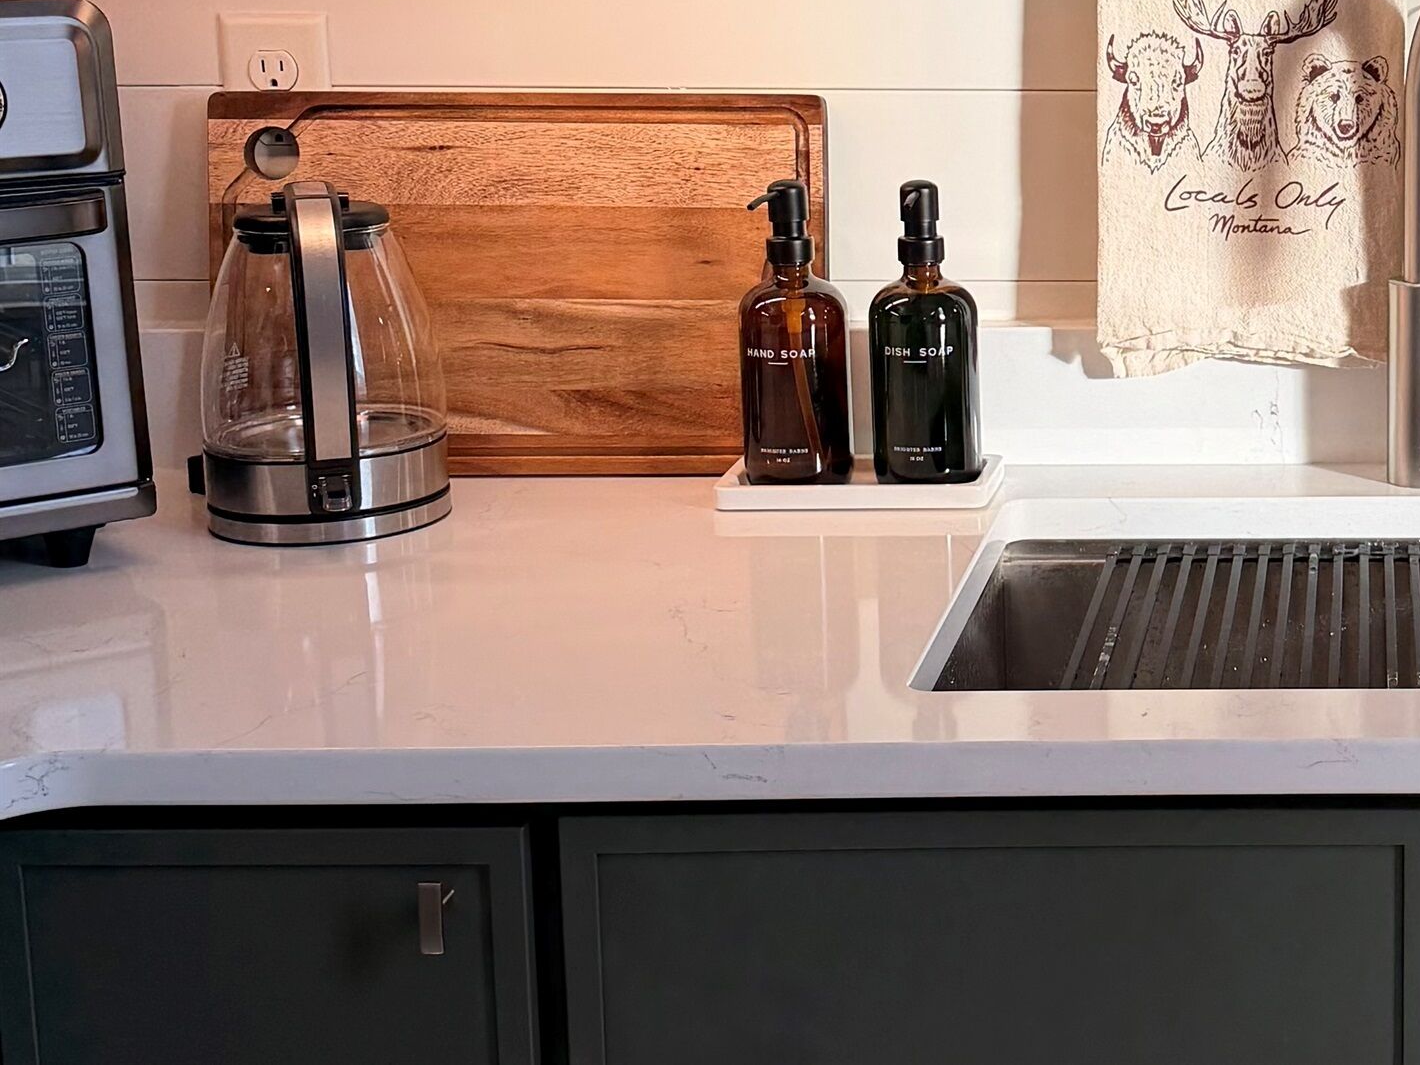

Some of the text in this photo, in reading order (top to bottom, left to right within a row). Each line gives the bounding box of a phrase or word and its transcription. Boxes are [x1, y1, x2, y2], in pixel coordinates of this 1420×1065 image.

[1164, 174, 1348, 230] Locals Only
[1209, 213, 1312, 241] Montana
[747, 347, 816, 359] HAND SOAP
[884, 346, 954, 357] DISH SOAP
